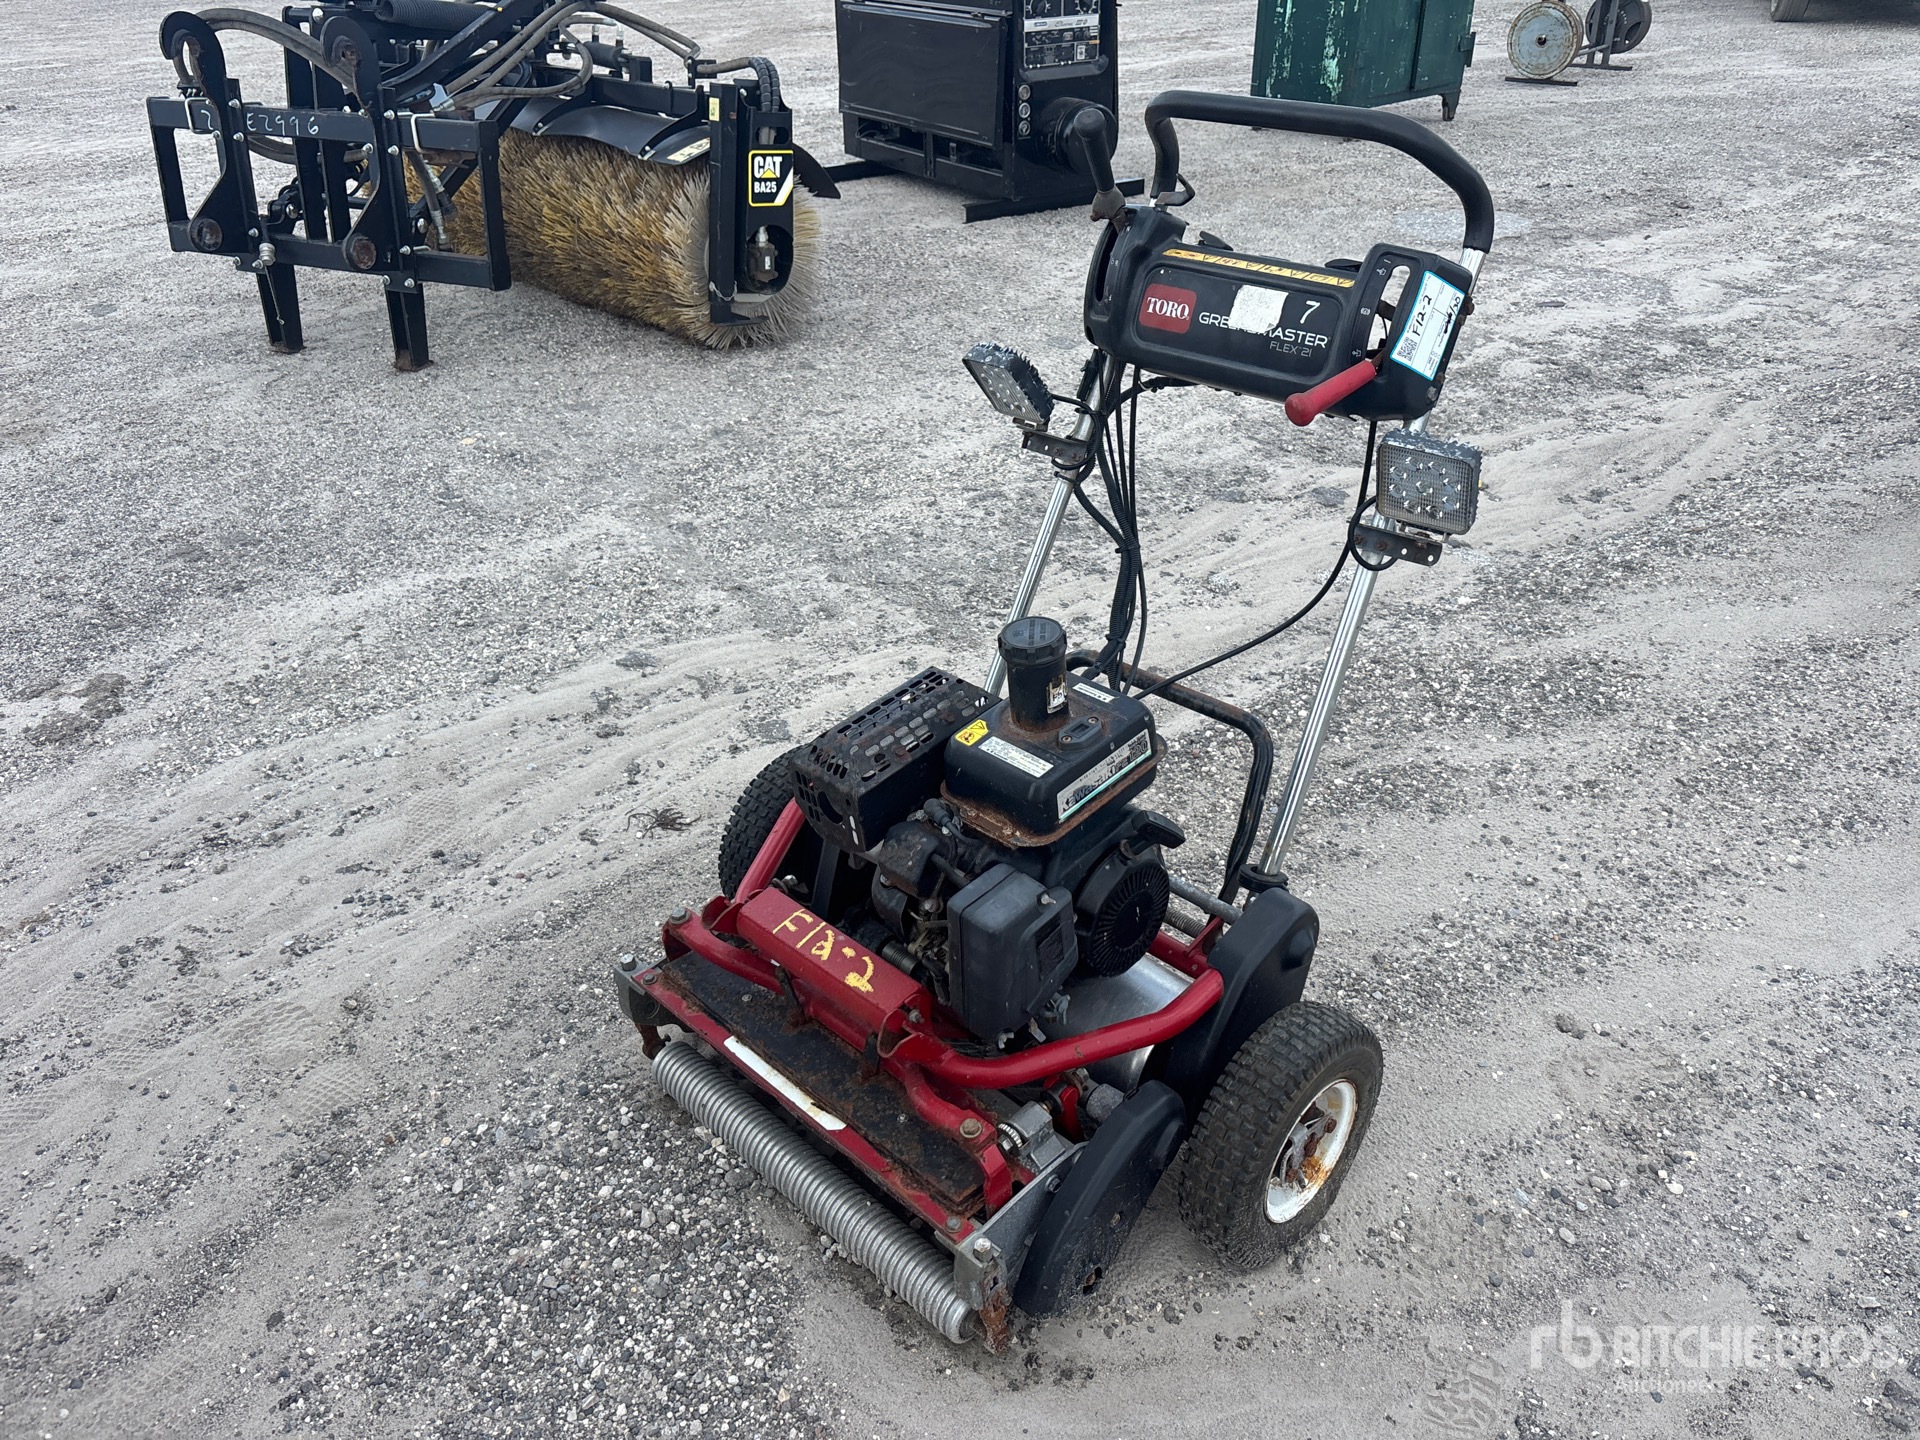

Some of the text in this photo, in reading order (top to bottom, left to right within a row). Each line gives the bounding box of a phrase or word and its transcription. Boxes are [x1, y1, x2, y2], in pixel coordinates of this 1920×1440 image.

[754, 156, 783, 178] CAT
[754, 181, 777, 193] BA25
[1146, 296, 1190, 320] TORO
[1299, 300, 1320, 324] 7
[1412, 295, 1432, 336] F12-2
[1269, 340, 1312, 358] FLEX 21
